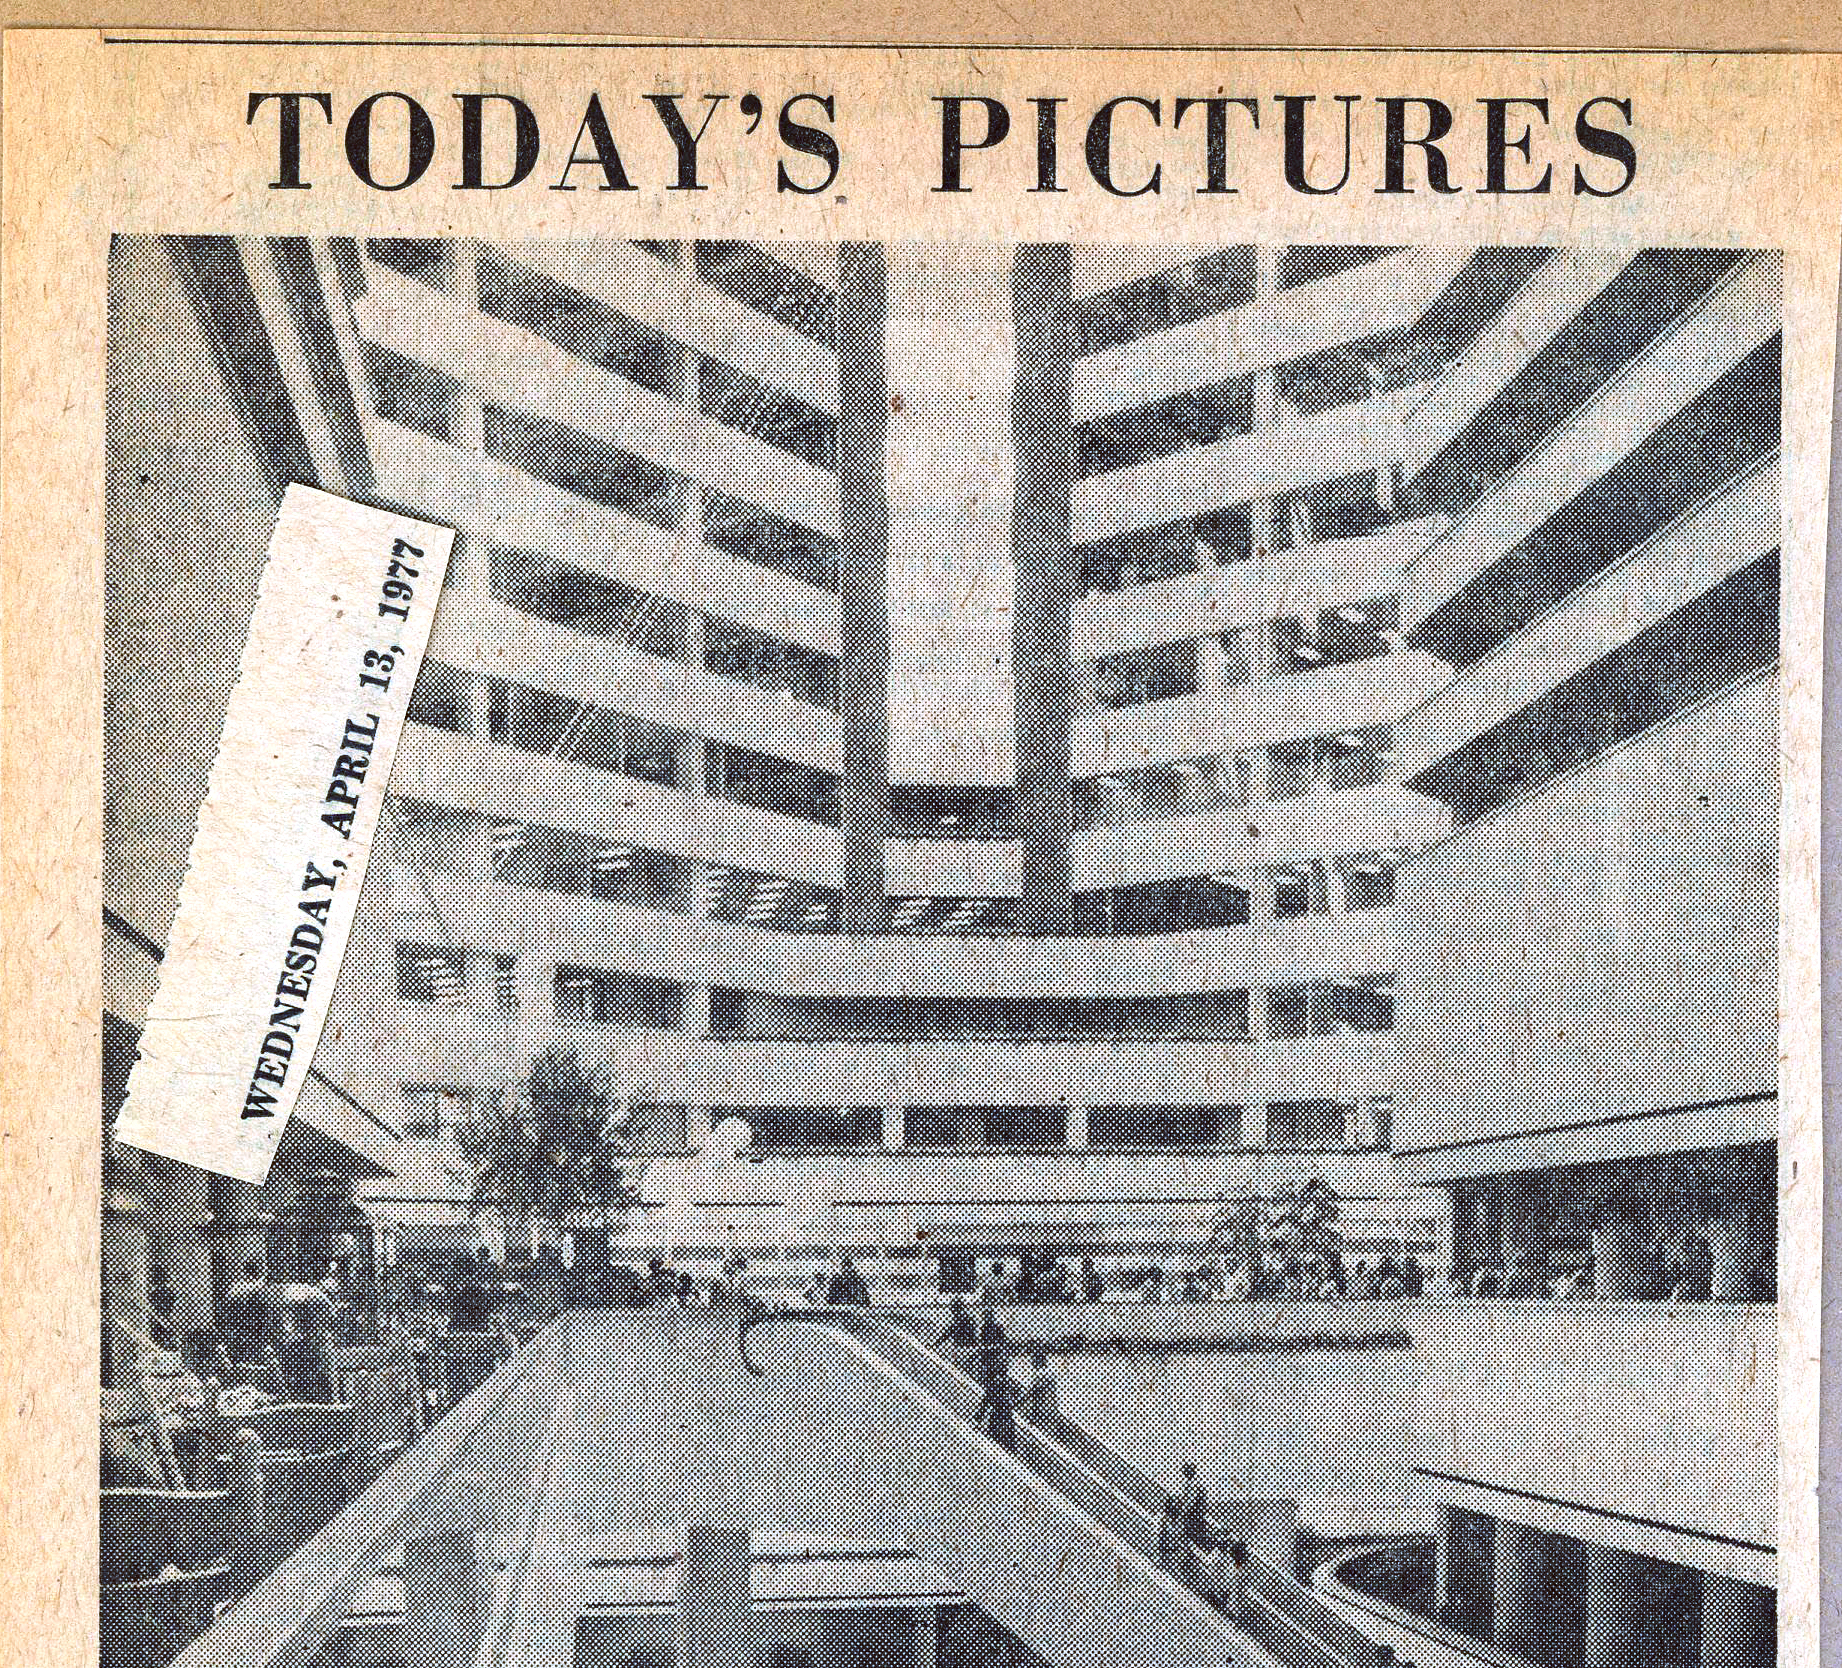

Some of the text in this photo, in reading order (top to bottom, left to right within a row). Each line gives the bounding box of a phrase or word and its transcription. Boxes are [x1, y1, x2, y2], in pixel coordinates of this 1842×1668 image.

[246, 91, 1637, 197] TODAY'S PICTURES
[241, 537, 425, 1123] WEDNESDAY, APRIL 13, 1977
